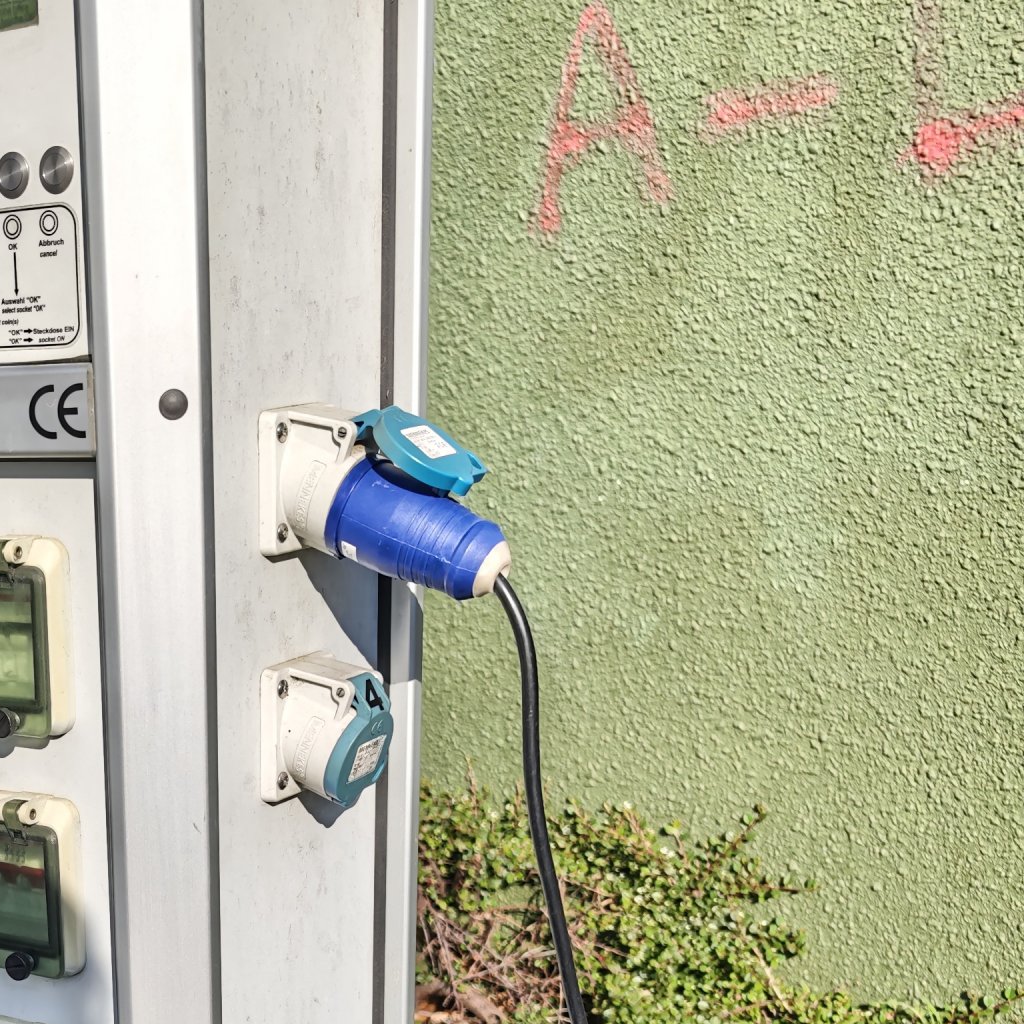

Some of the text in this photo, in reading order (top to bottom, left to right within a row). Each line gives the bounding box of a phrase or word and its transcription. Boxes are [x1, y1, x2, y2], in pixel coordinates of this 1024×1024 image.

[8, 243, 18, 251] OK
[38, 238, 65, 247] Abbruch
[39, 249, 58, 258] cancel
[1, 297, 26, 305] Auswahl
[17, 305, 32, 313] socket
[29, 382, 86, 440] CE
[365, 678, 385, 711] 4
